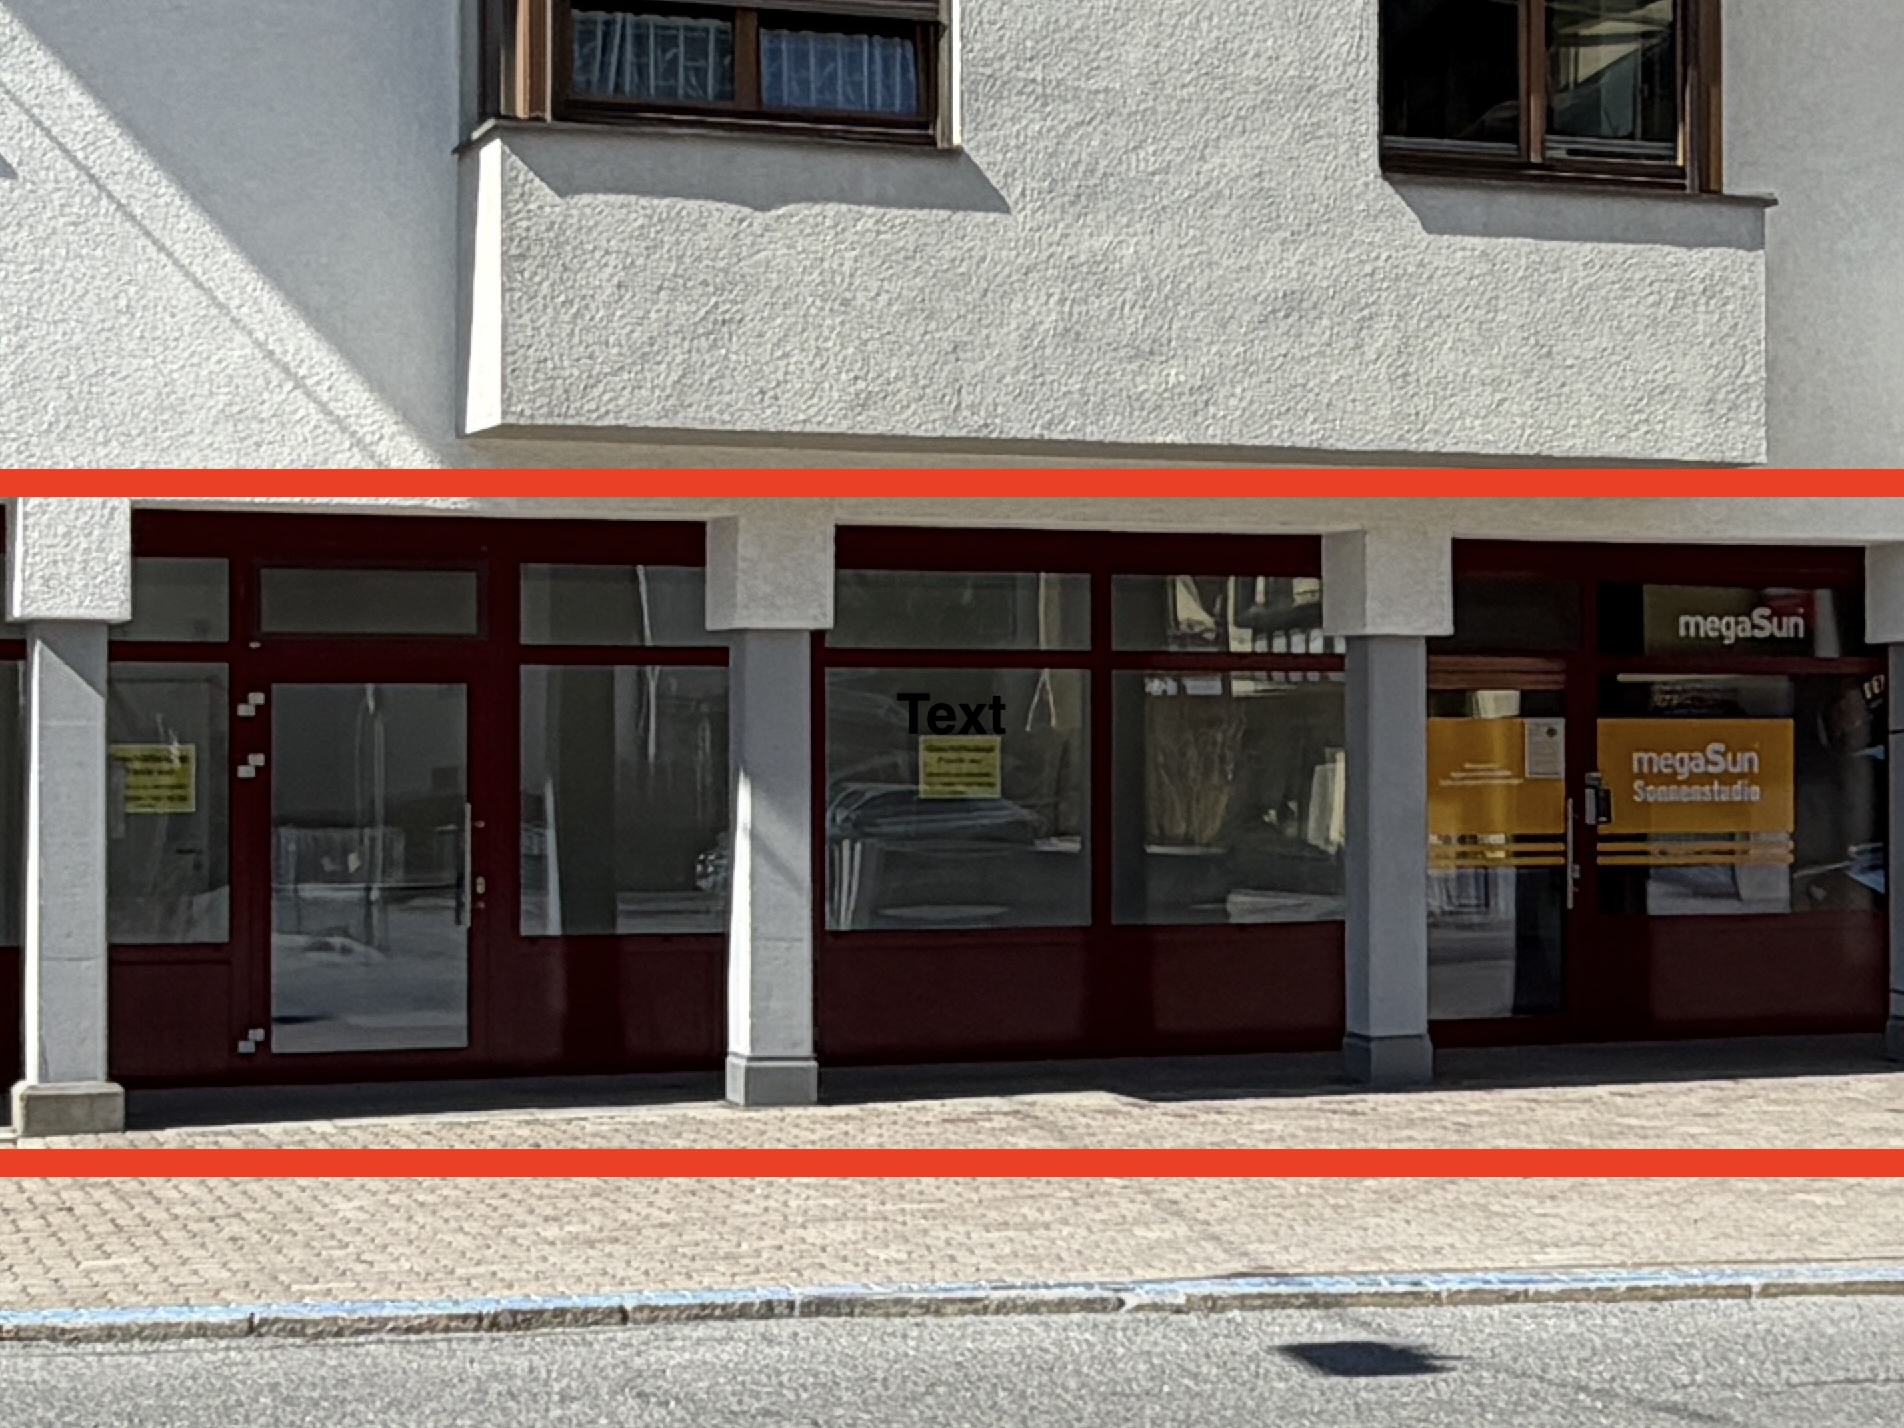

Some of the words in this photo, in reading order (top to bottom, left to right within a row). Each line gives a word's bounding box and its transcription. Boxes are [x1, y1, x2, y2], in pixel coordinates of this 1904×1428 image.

[1678, 606, 1805, 645] megaSun
[1632, 743, 1760, 780] megaSun
[1633, 780, 1761, 805] Sonnenstudio
